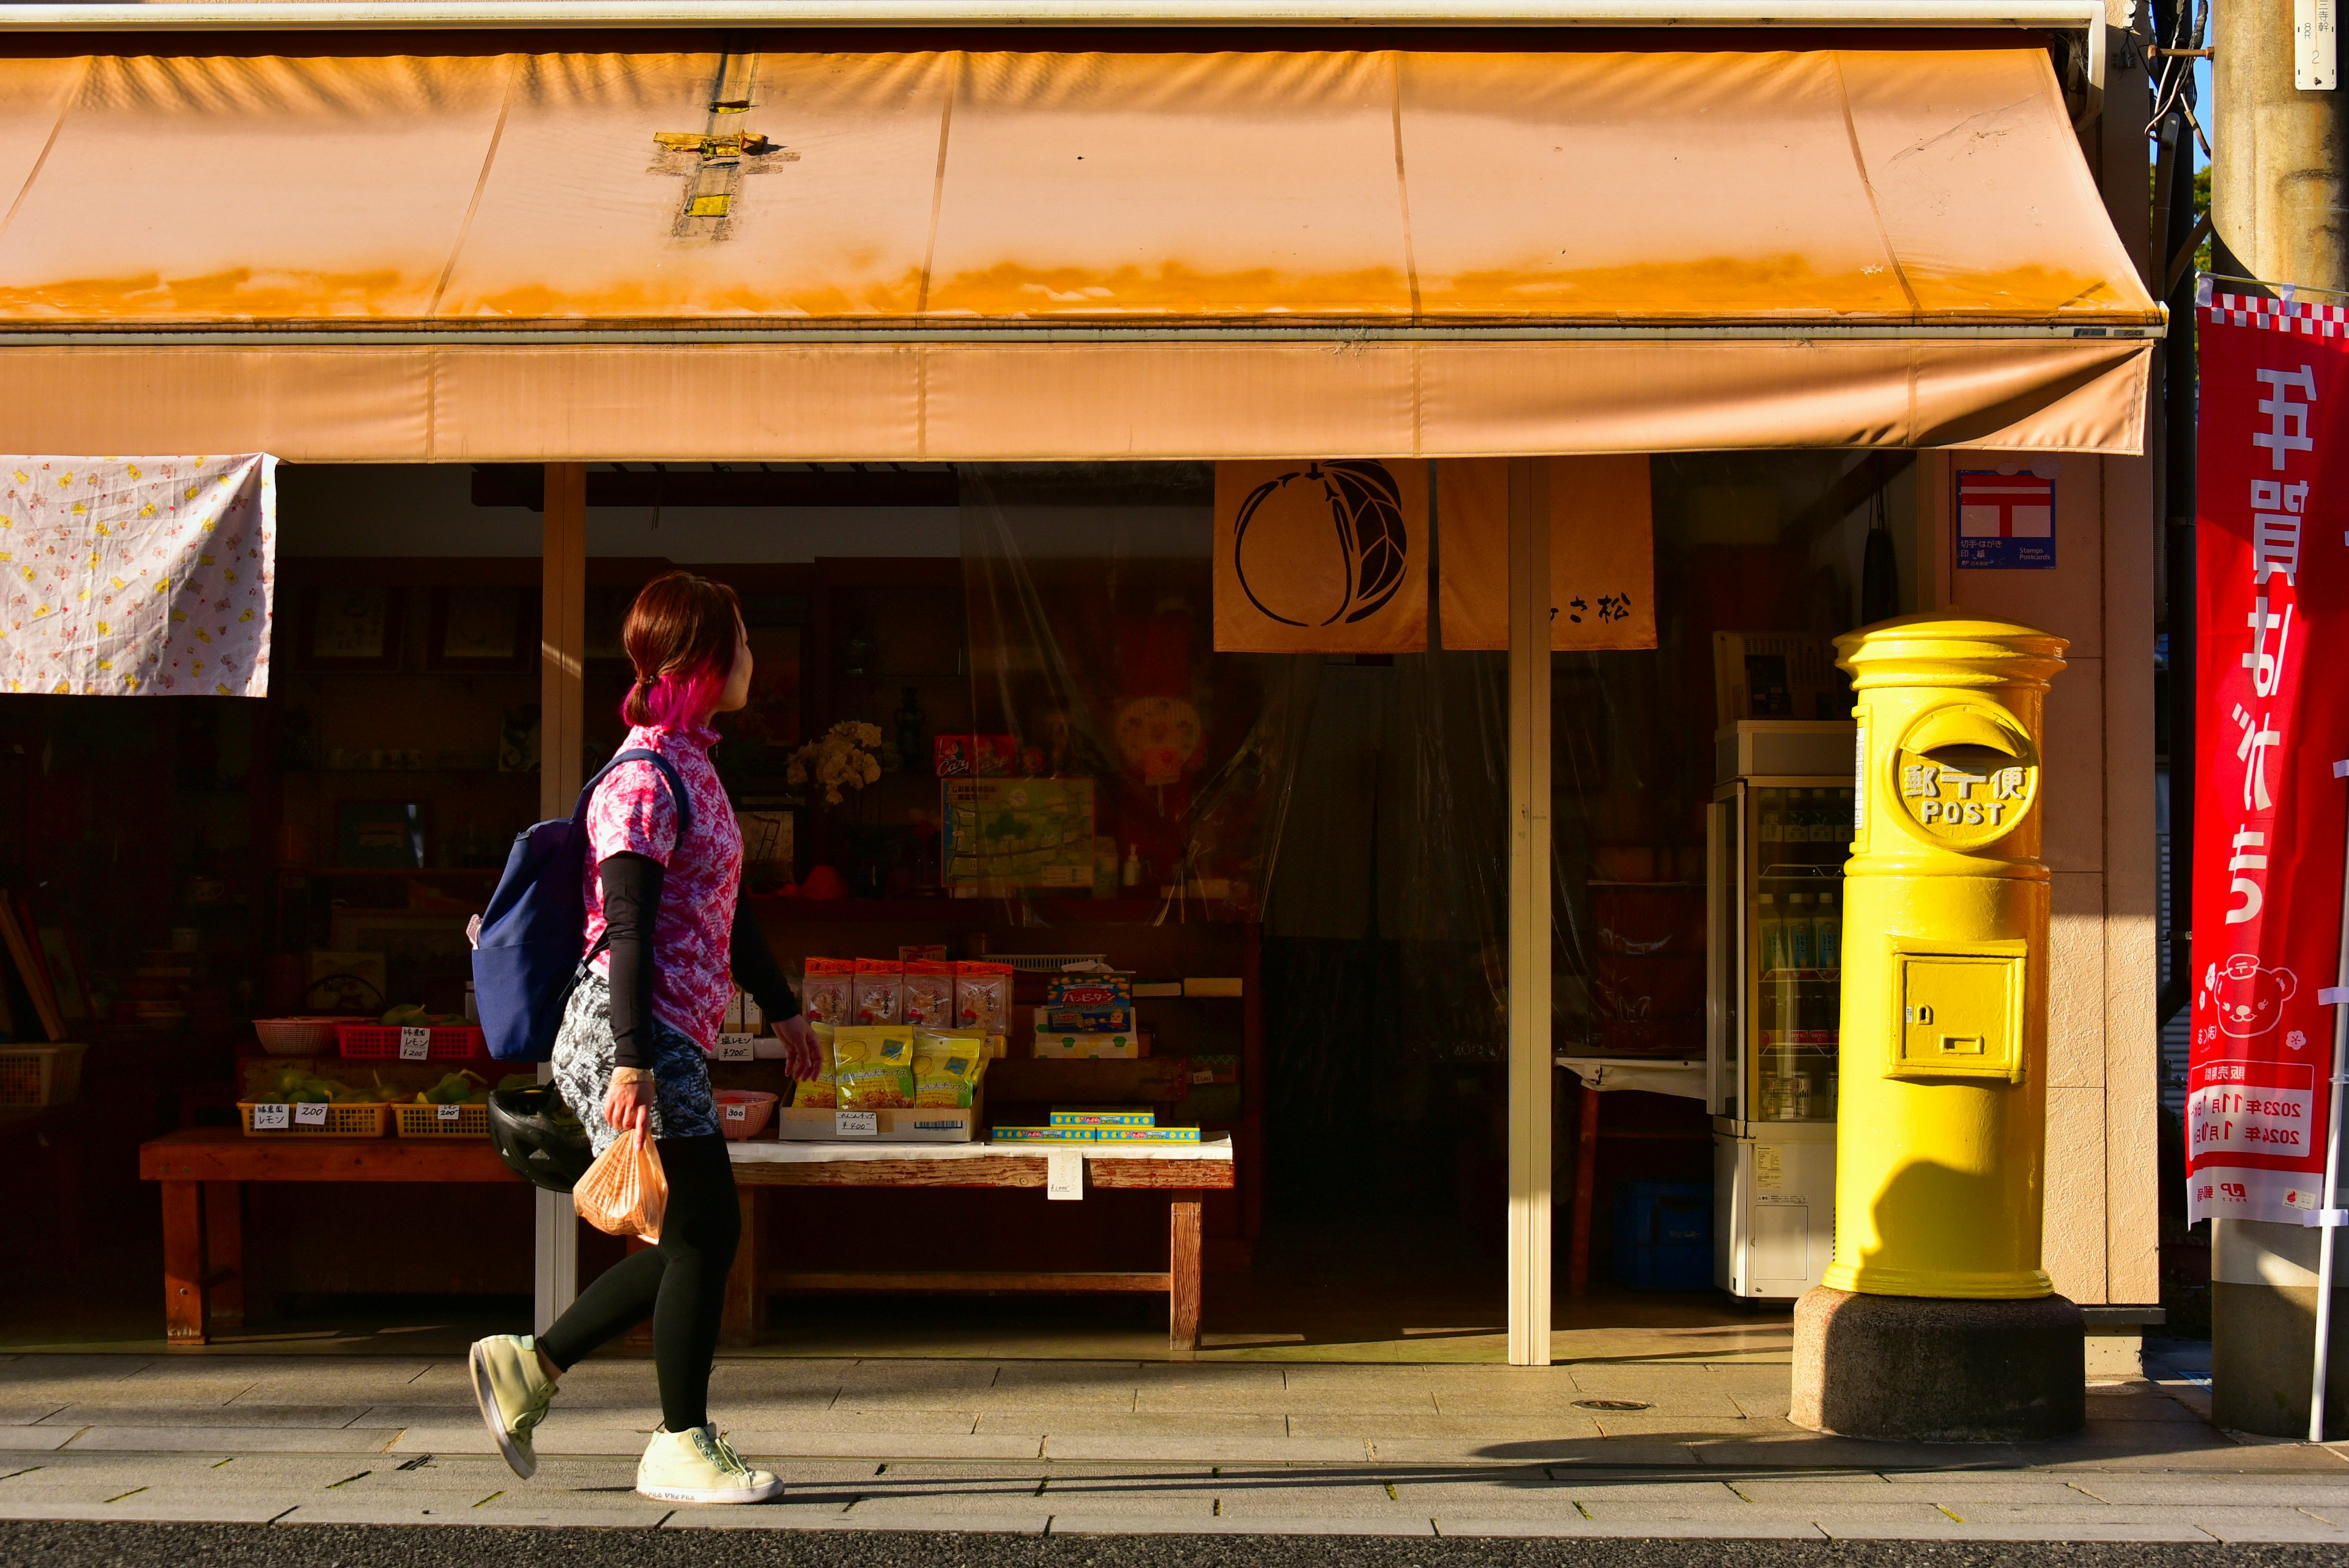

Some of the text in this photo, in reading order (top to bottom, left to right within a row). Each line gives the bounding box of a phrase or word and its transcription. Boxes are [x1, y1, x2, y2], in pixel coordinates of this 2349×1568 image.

[2312, 50, 2320, 64] 2
[1961, 540, 2002, 548] 切手・はがき
[1921, 800, 2006, 826] POST
[406, 1037, 428, 1046] レモン
[721, 1036, 751, 1045] 塩レモン
[259, 1115, 284, 1124] レモン
